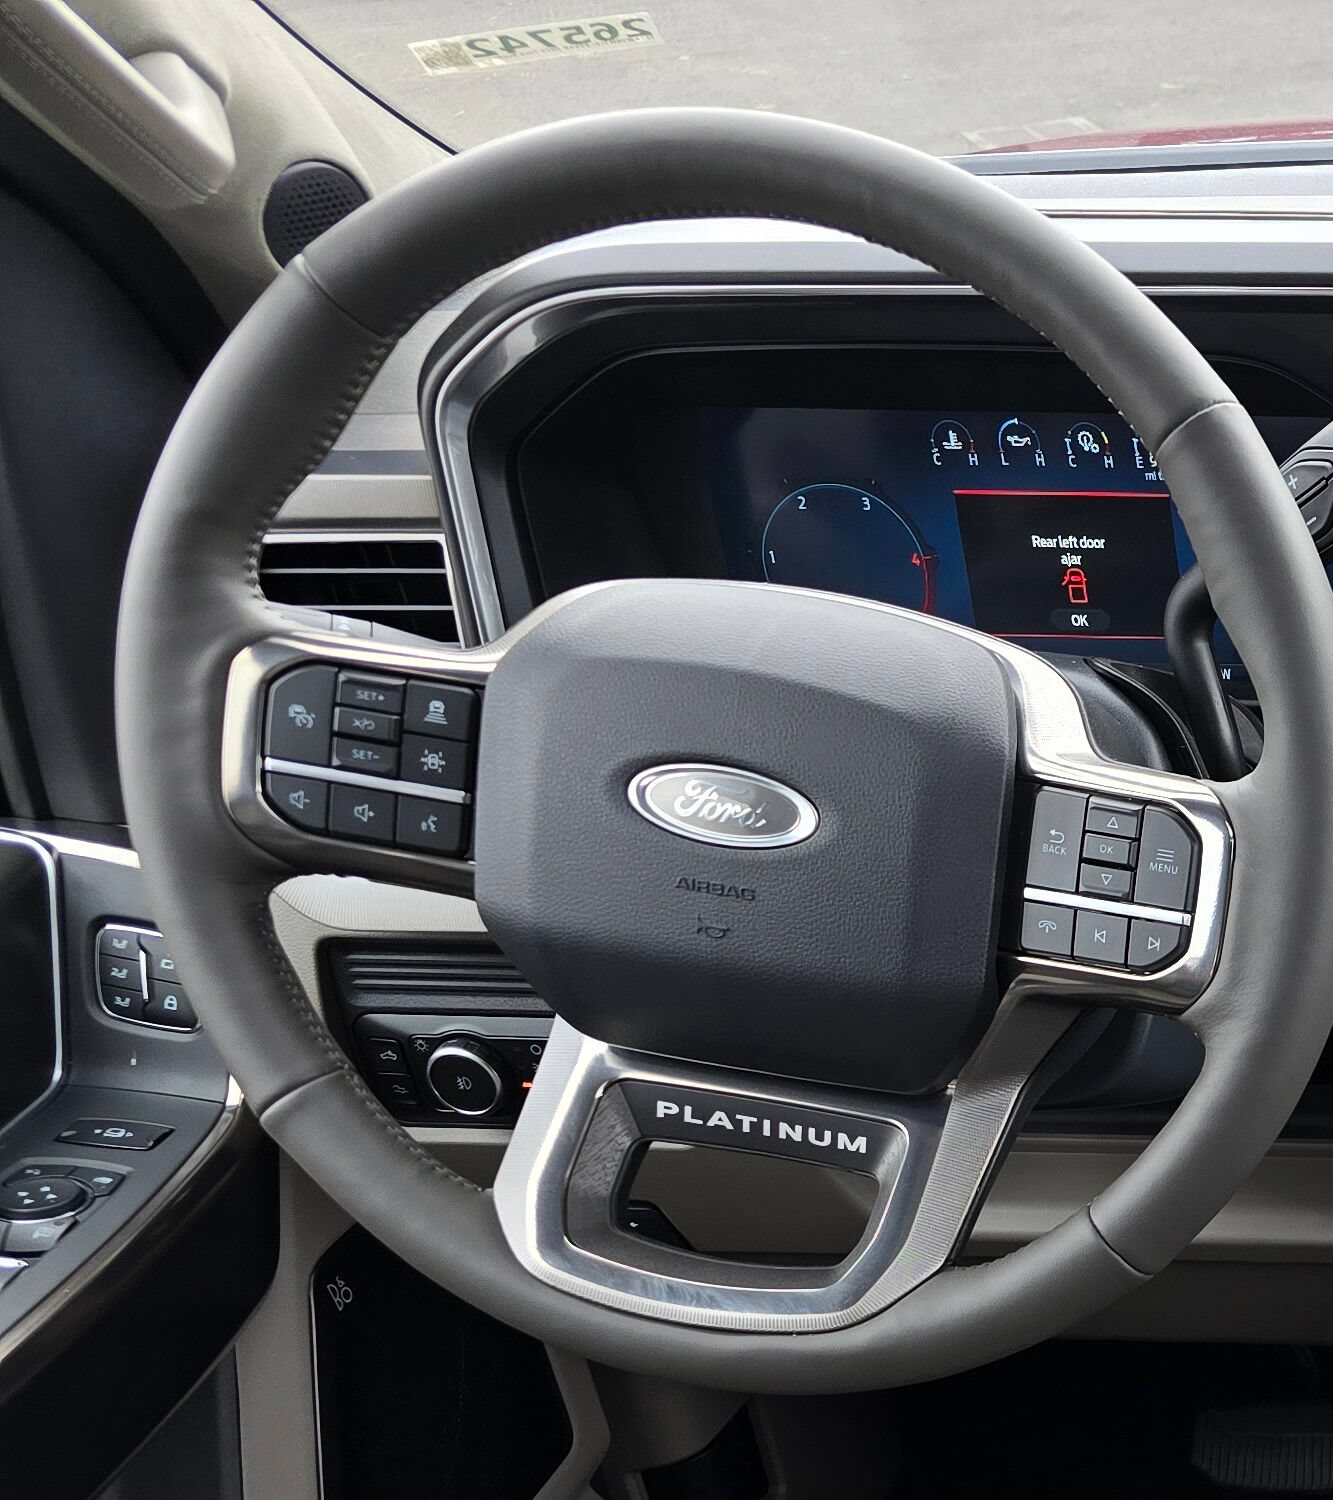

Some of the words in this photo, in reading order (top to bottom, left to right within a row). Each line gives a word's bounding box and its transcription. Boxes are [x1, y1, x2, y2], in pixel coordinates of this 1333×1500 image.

[797, 496, 807, 510] 2
[861, 497, 871, 511] 3
[1031, 535, 1057, 549] Rear
[1058, 536, 1078, 549] left
[1079, 535, 1106, 549] door
[1060, 553, 1082, 568] ajar
[1070, 615, 1089, 627] OK
[673, 778, 767, 829] Ford
[1042, 843, 1067, 856] BACK
[1099, 844, 1114, 855] OK
[1150, 862, 1179, 875] MENU
[674, 876, 756, 901] AIRBAG
[656, 1100, 868, 1154] PLATINUM
